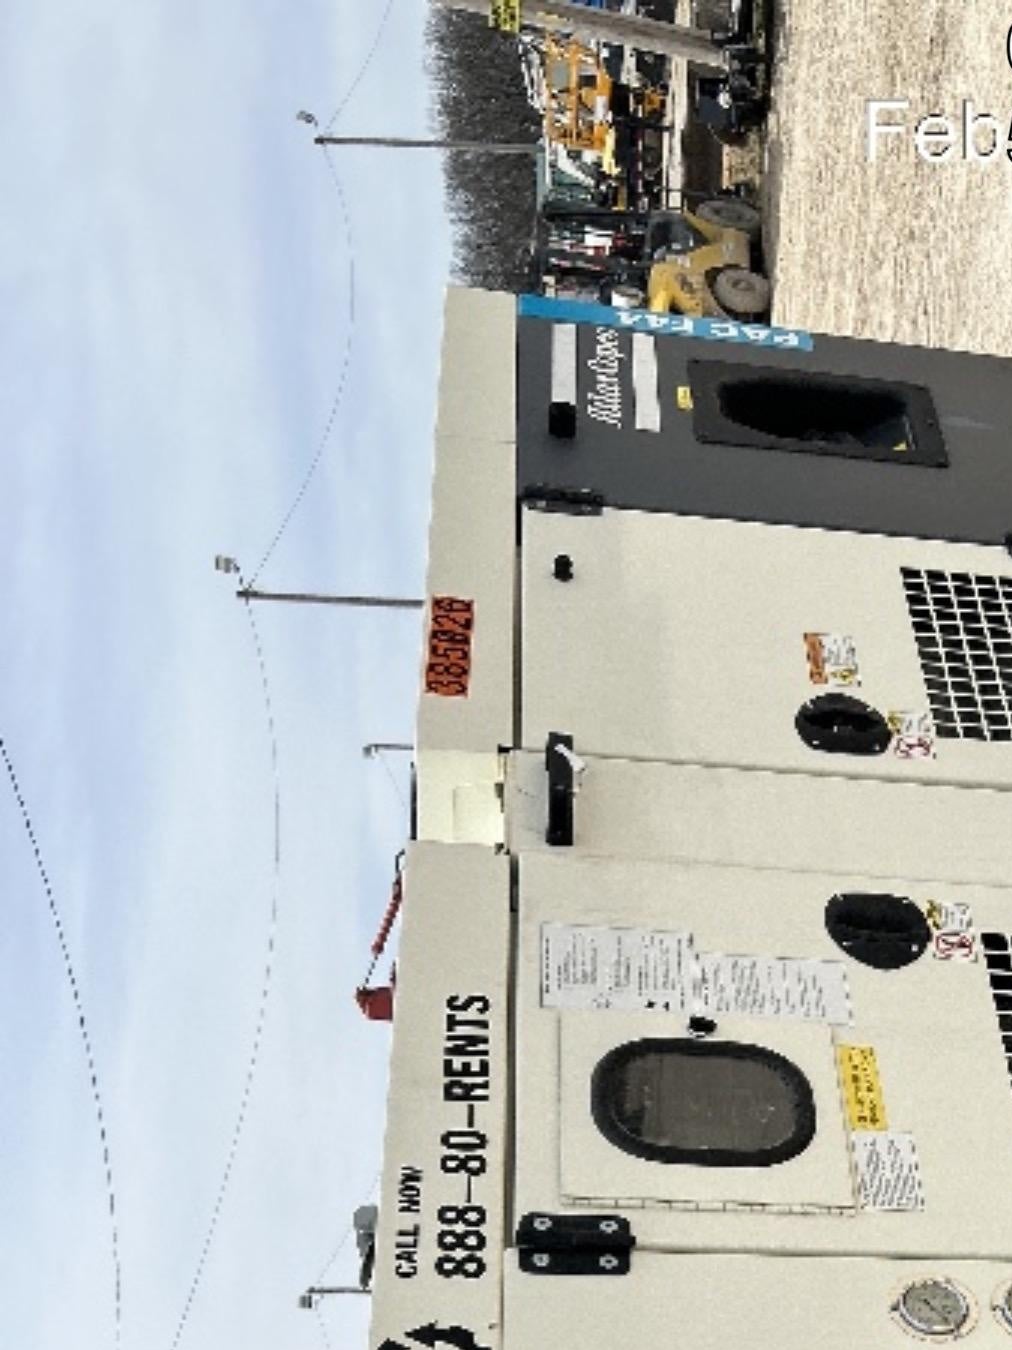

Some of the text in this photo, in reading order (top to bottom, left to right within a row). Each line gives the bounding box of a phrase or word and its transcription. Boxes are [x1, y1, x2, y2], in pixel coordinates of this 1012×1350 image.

[395, 1165, 423, 1278] CALL NOW
[434, 995, 489, 1278] 888-80-RENTS
